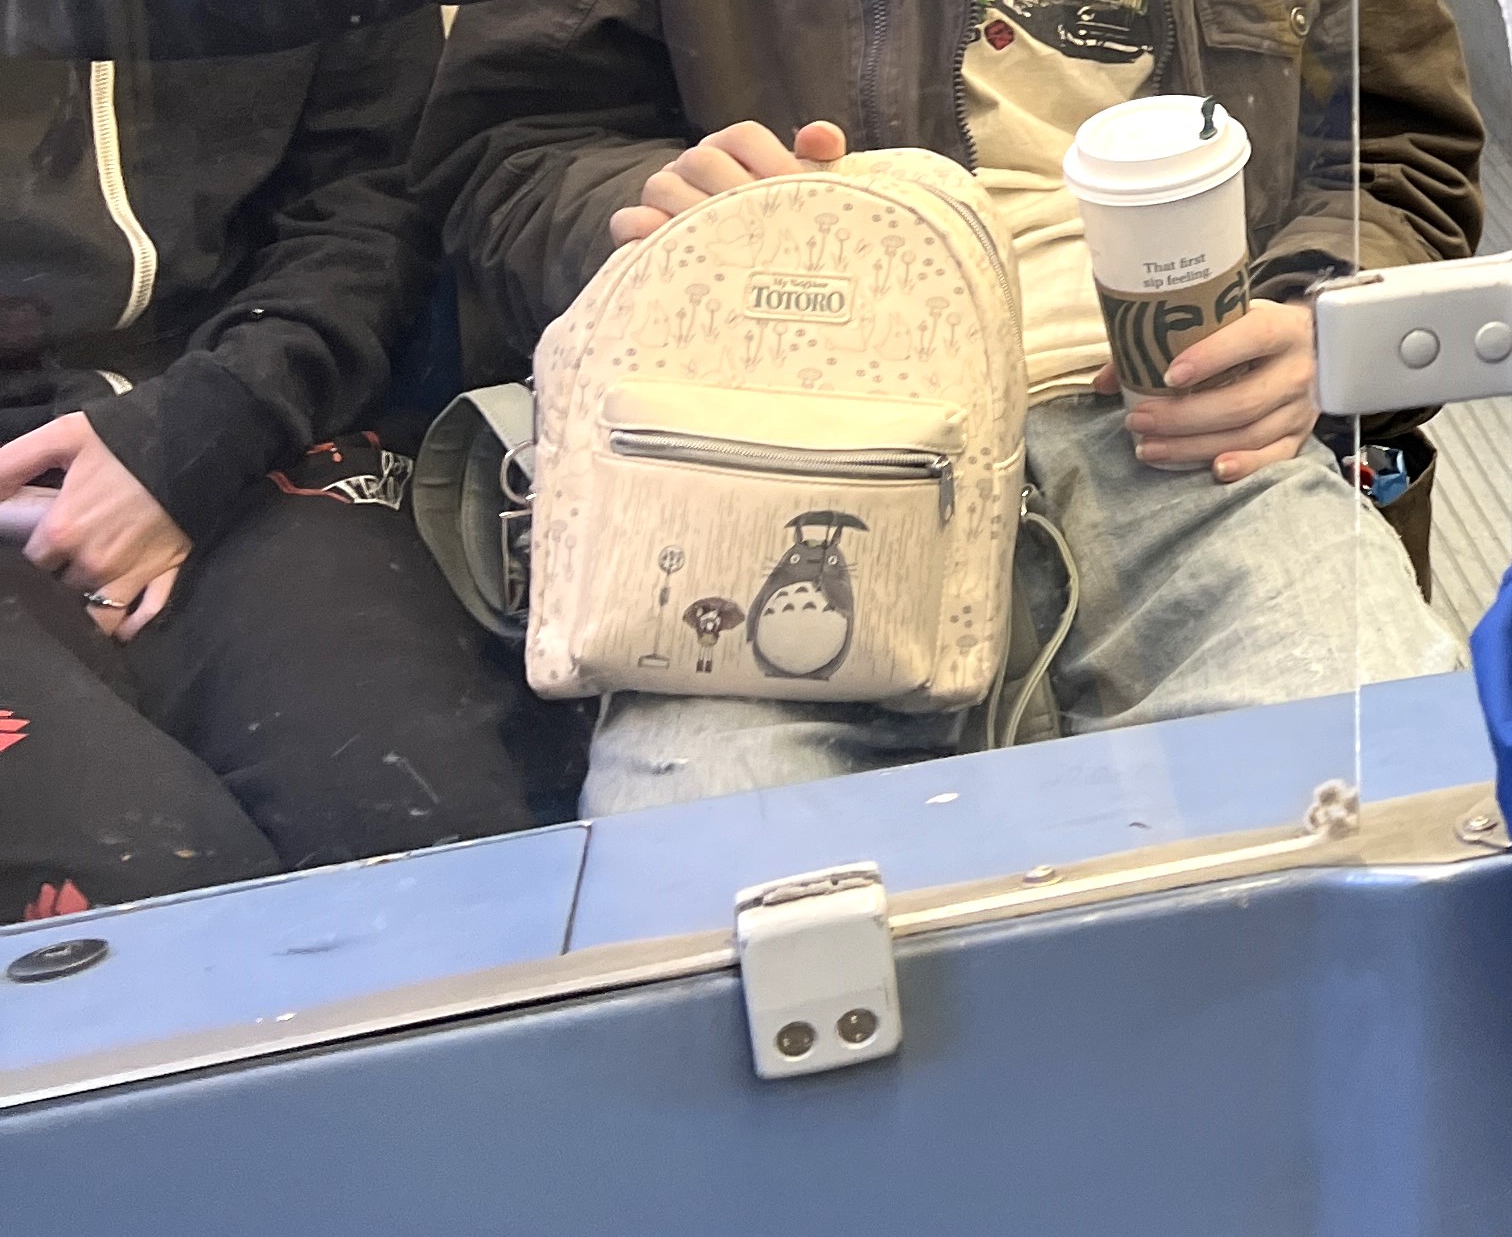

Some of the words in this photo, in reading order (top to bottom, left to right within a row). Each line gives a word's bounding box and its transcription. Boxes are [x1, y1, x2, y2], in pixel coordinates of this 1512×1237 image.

[1143, 261, 1175, 274] That
[1180, 253, 1206, 269] first
[1143, 276, 1164, 290] sip
[752, 285, 846, 314] TOTORO
